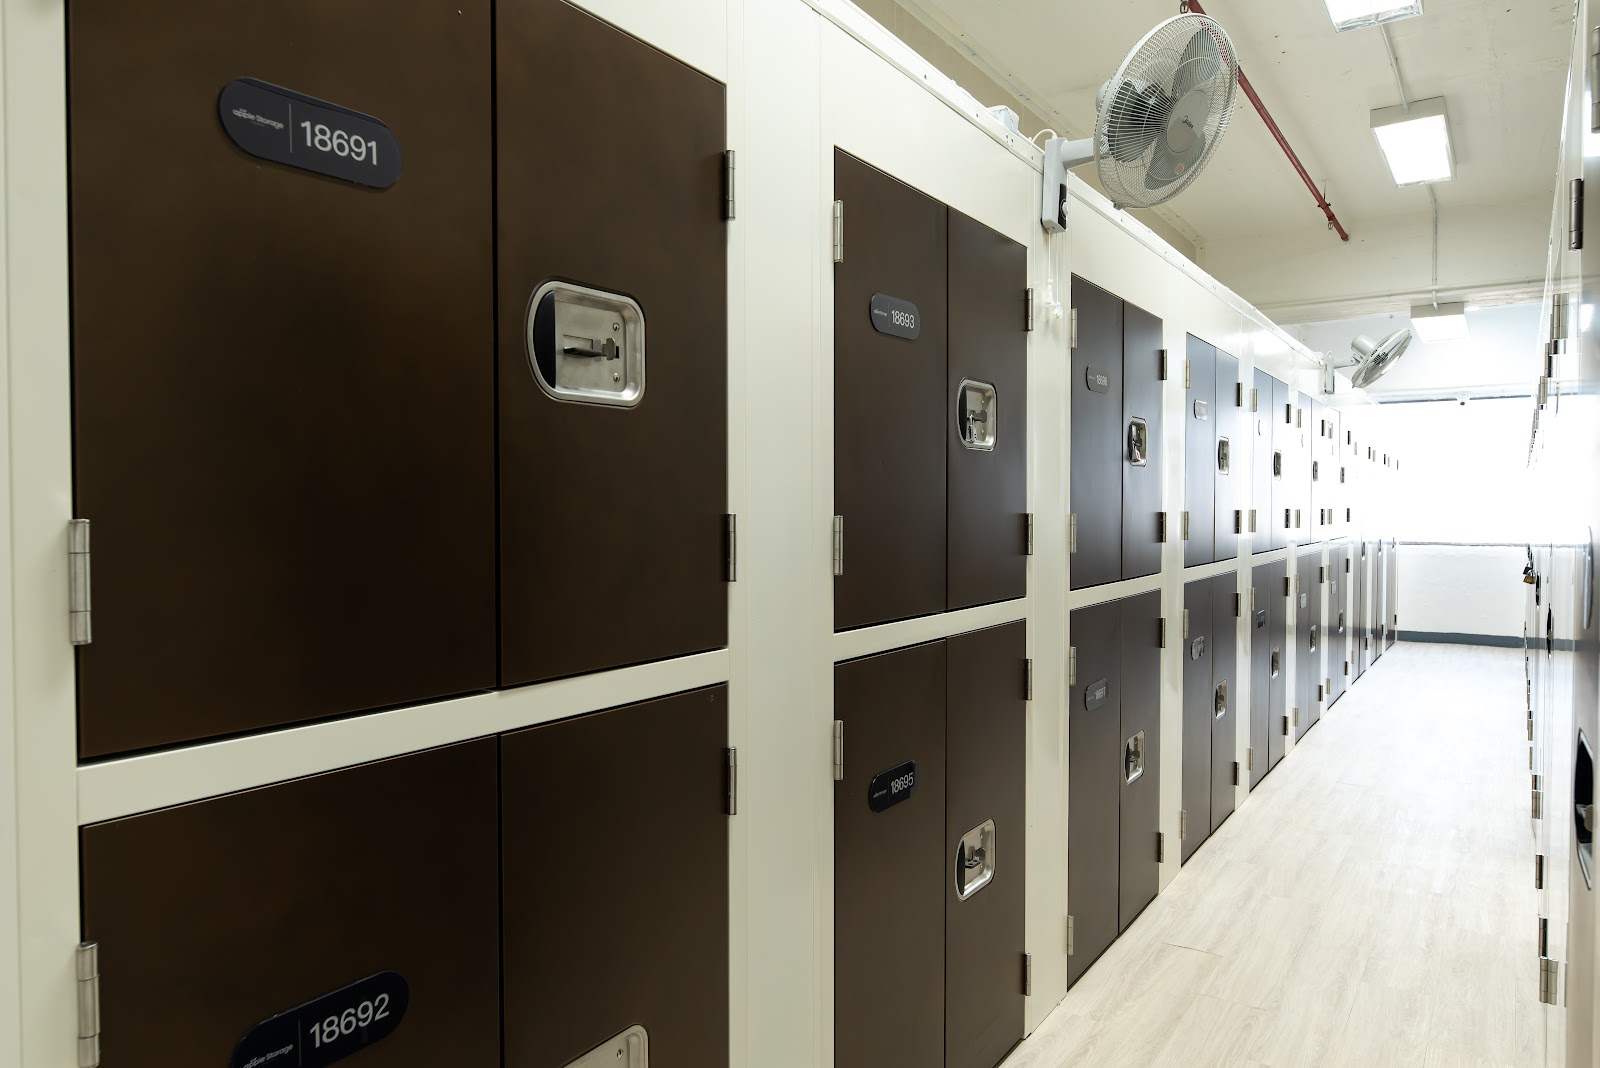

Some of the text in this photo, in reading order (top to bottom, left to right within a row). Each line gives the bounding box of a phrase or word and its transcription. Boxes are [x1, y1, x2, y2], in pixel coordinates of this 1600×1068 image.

[256, 114, 285, 130] Storage
[300, 120, 378, 166] 18691
[891, 309, 915, 329] 18693
[890, 771, 914, 795] 18695
[266, 1043, 294, 1061] Storage
[309, 992, 390, 1049] 18692
